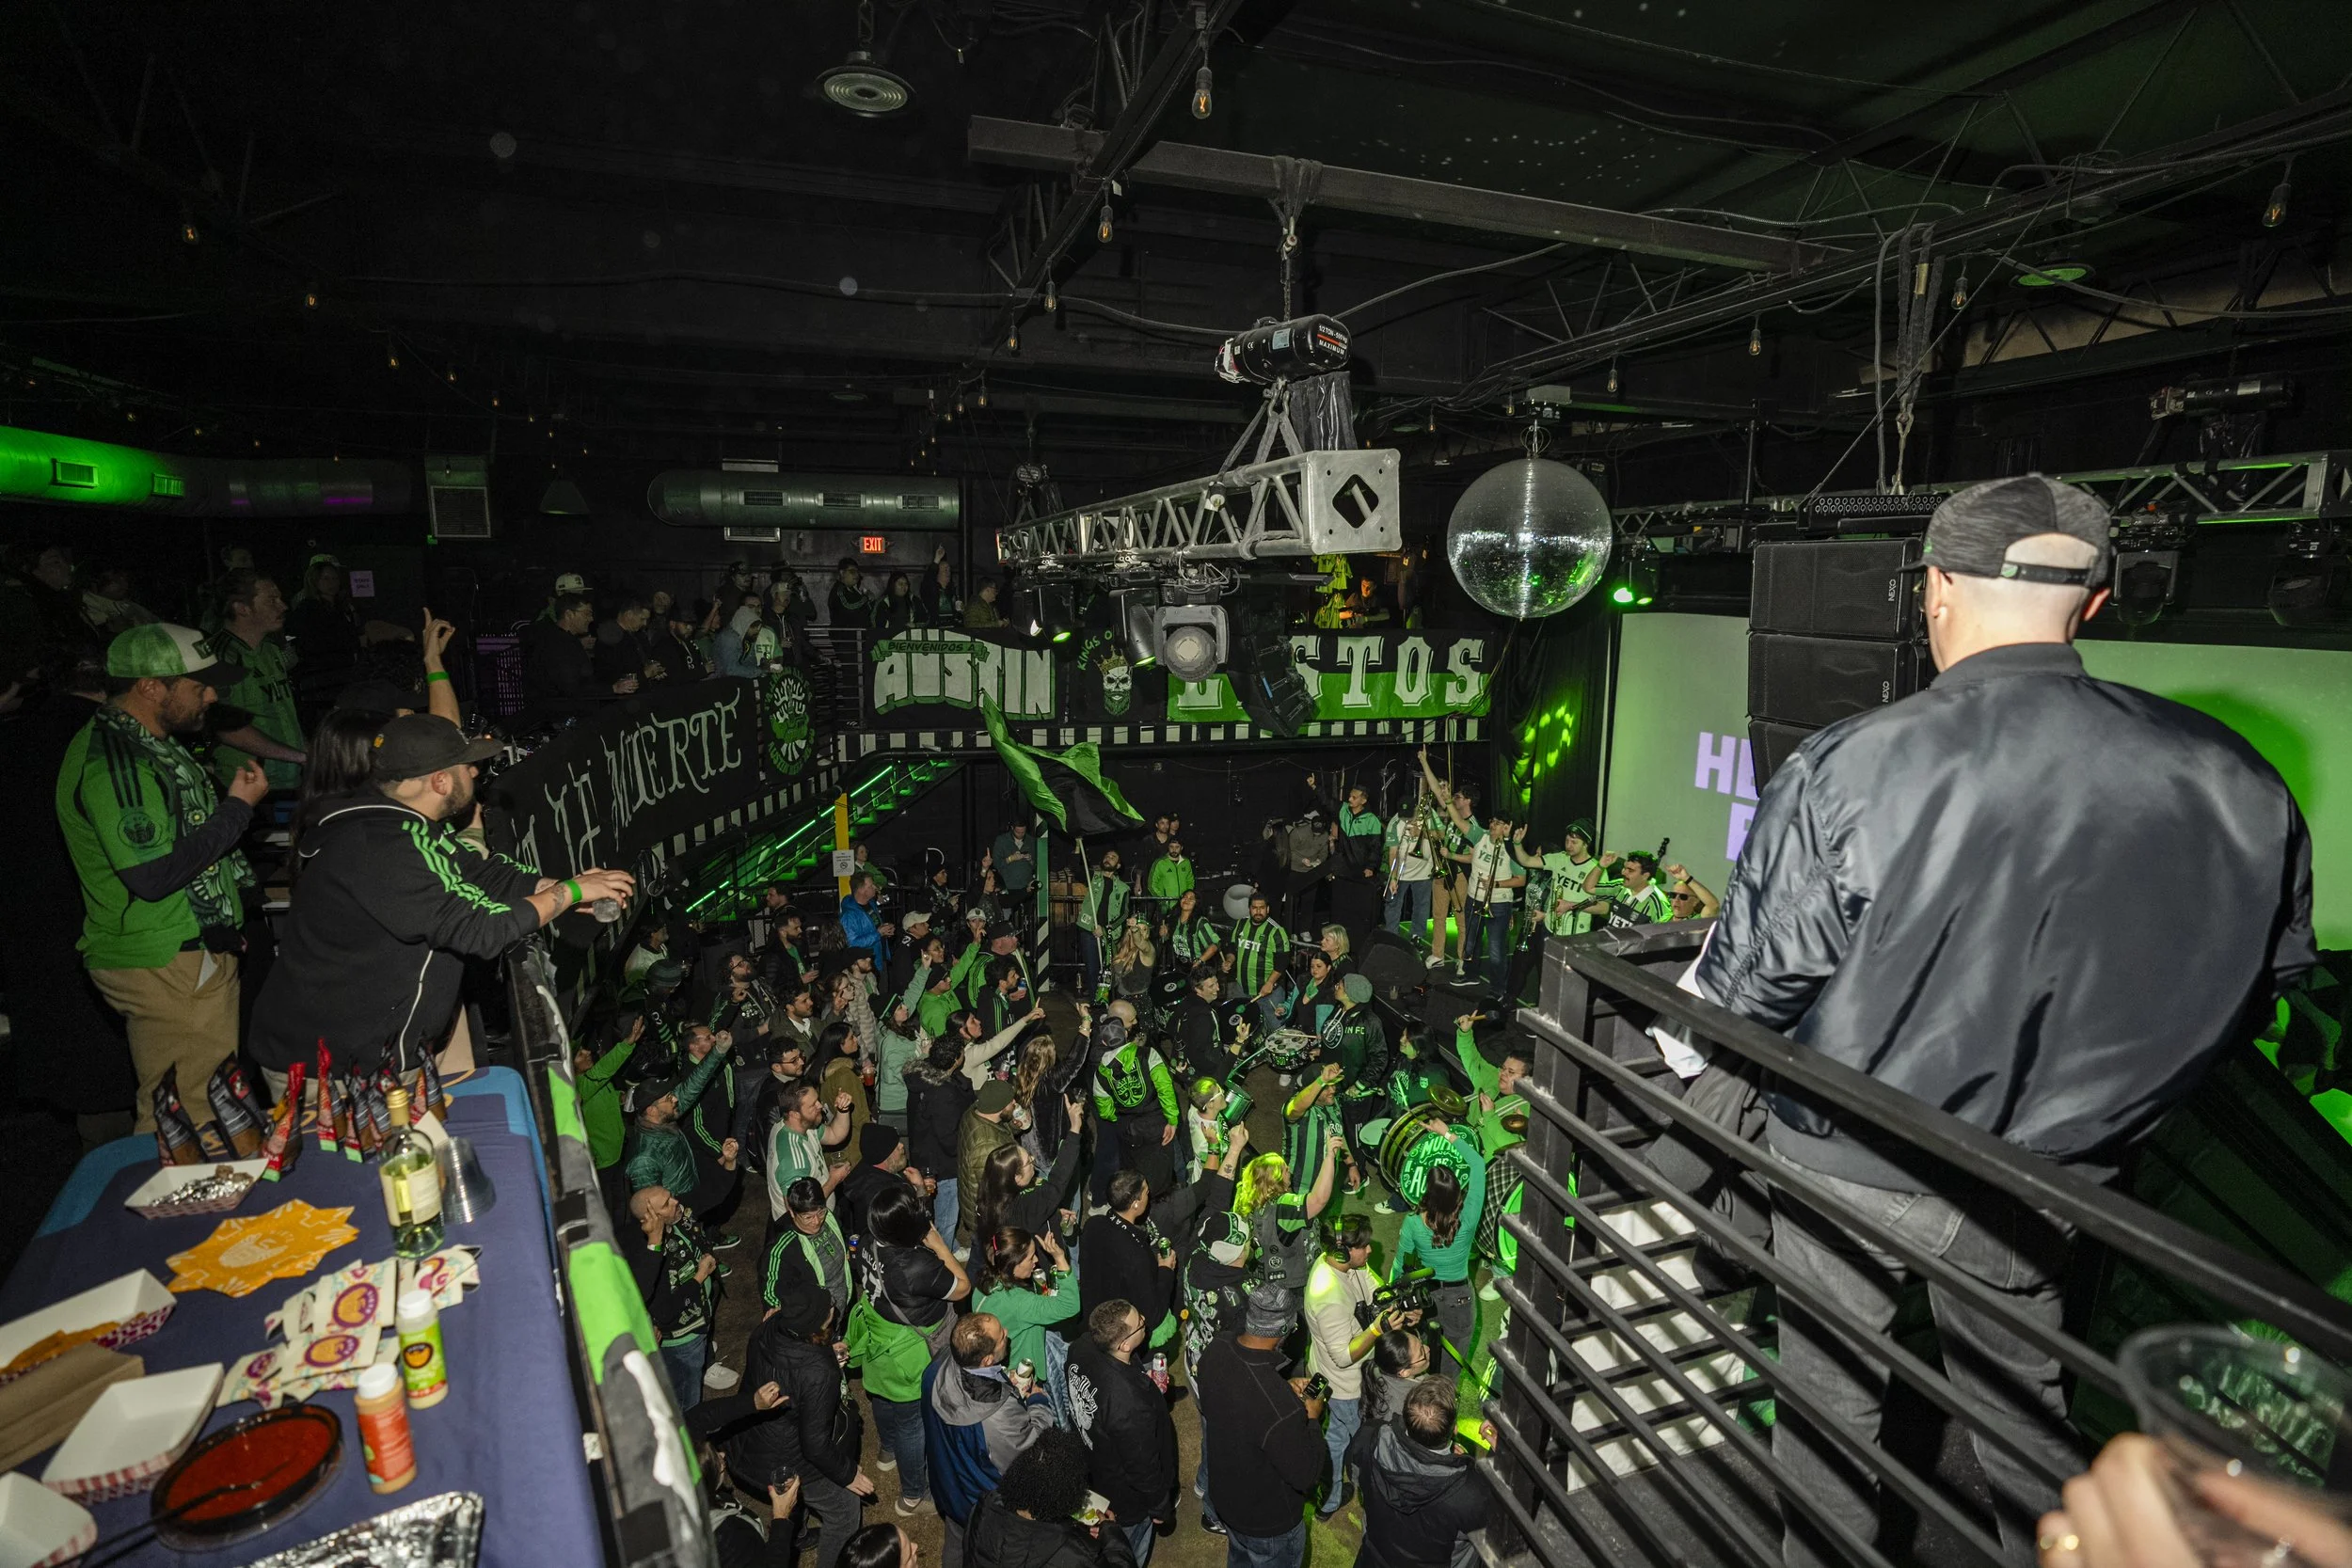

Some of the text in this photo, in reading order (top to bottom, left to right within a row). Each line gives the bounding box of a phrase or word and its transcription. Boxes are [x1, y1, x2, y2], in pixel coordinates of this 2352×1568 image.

[1318, 339, 1345, 356] MAXIMUM
[863, 537, 882, 551] EXIT
[1887, 578, 1897, 602] NEXO
[755, 644, 772, 654] ETI
[887, 641, 976, 652] BIENVENIDOS A
[1076, 635, 1101, 671] KINGS
[873, 628, 1056, 721] AUSTIN
[1882, 680, 1890, 704] NEXO
[1478, 849, 1503, 867] YEI
[1557, 873, 1582, 894] YETI
[1238, 938, 1262, 953] YETI
